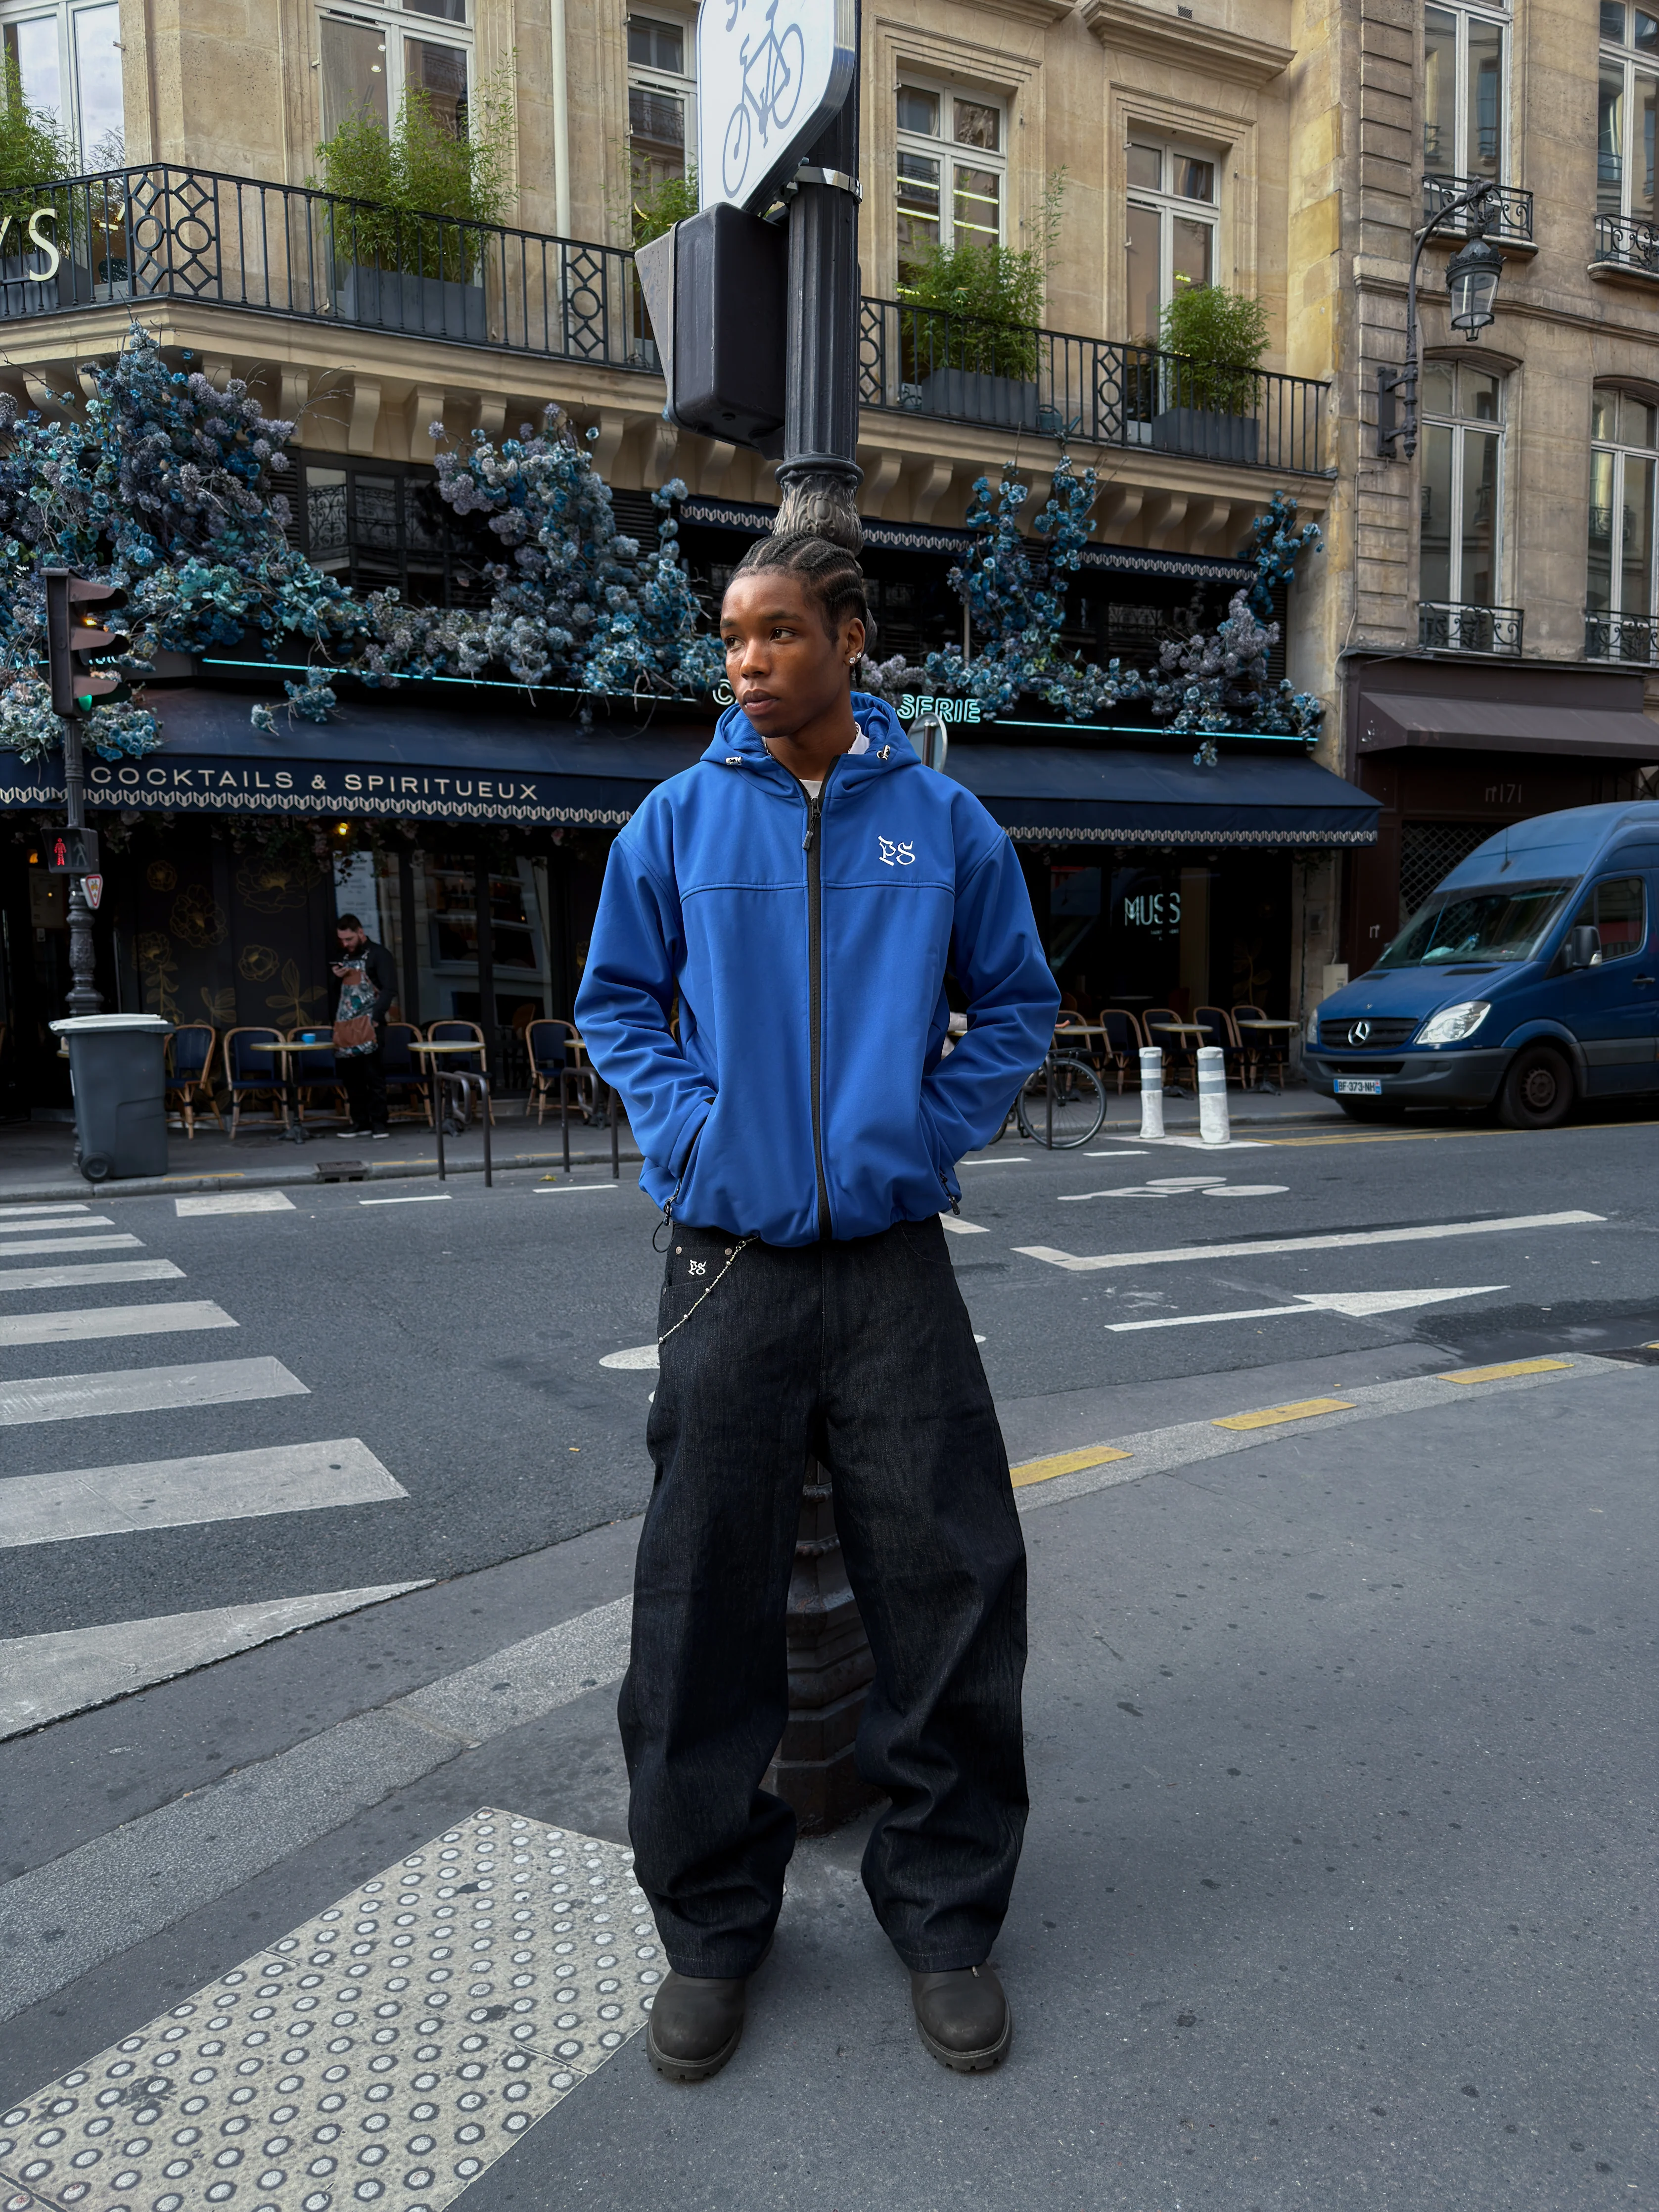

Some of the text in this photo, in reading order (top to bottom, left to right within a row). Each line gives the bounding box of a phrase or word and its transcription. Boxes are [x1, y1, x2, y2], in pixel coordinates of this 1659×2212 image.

[893, 693, 981, 724] SERIE
[91, 766, 538, 801] COCKTAILS & SPIRITUEUX
